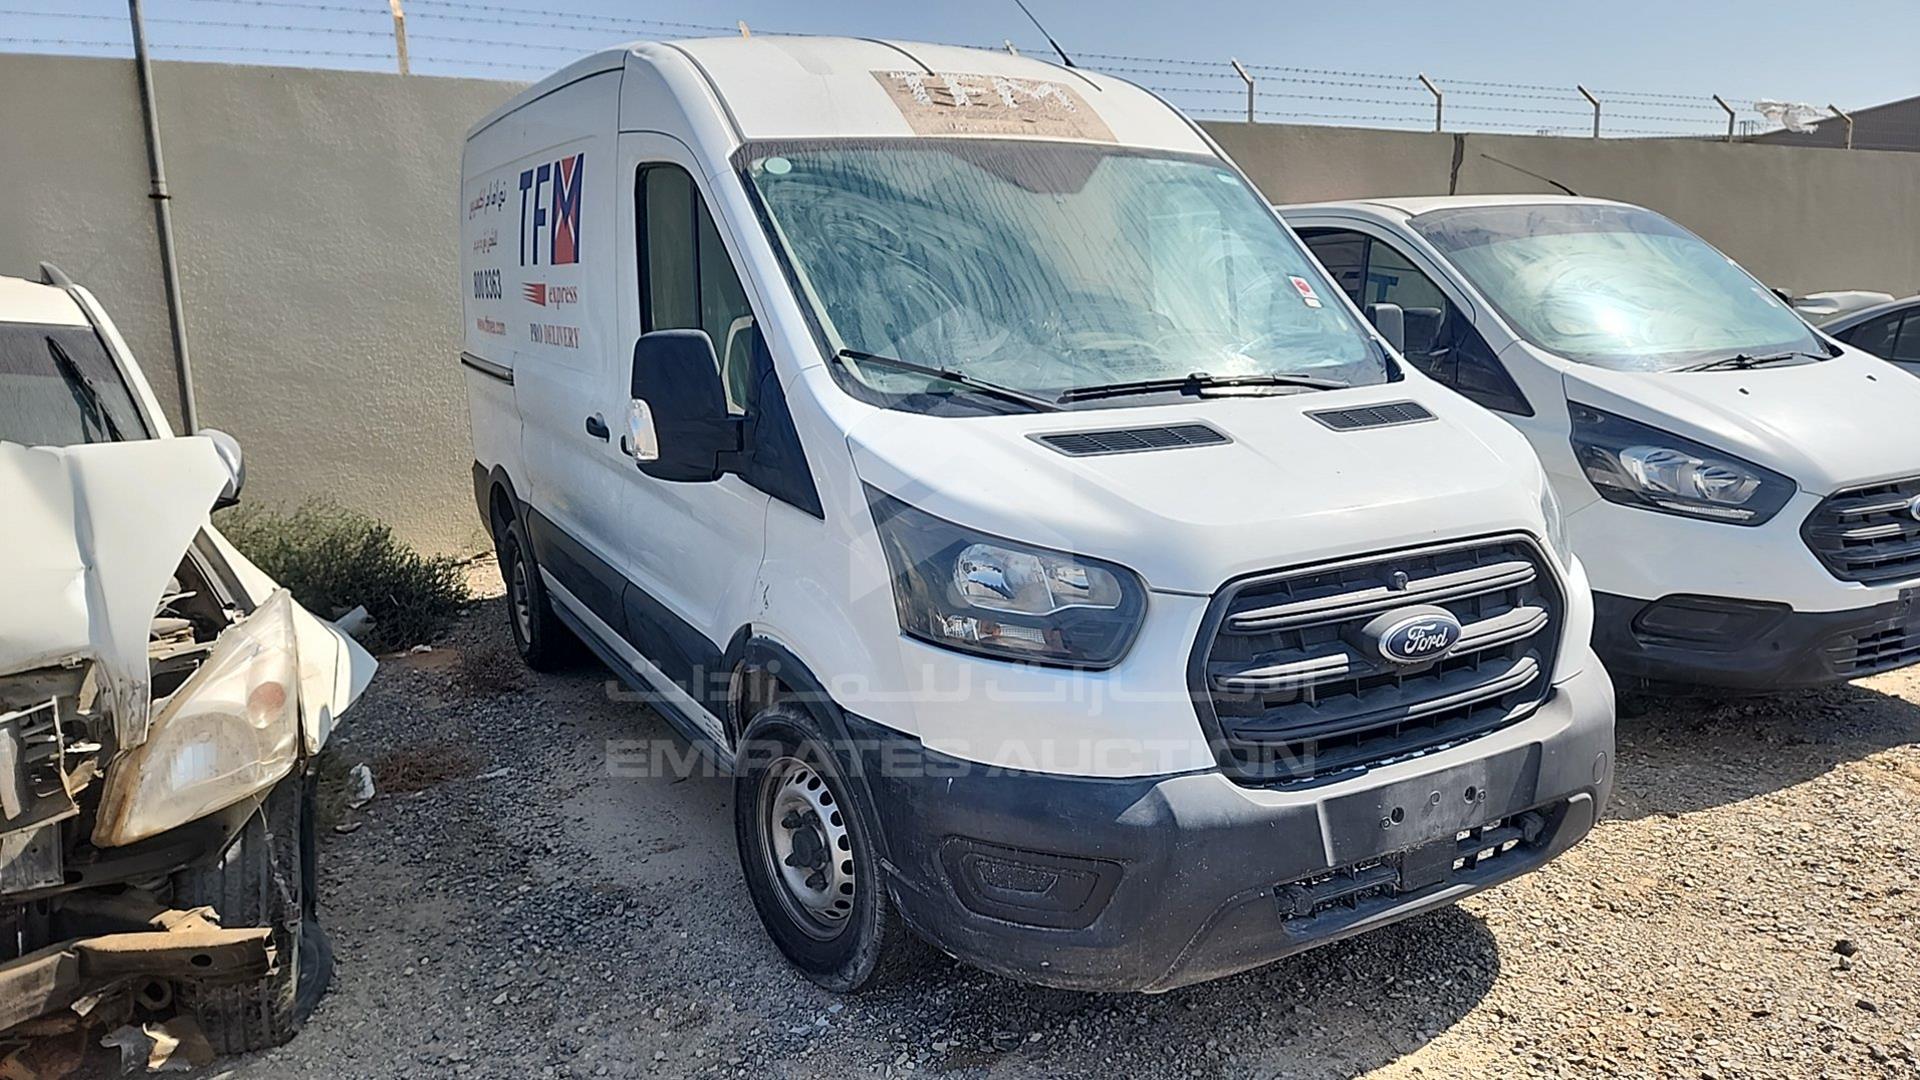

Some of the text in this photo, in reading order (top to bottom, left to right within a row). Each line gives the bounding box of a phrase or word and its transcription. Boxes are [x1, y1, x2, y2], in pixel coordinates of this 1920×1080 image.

[887, 71, 1078, 112] TFM
[519, 153, 584, 266] TFM
[549, 286, 578, 310] express
[530, 323, 543, 344] PRO
[544, 324, 580, 349] DELIVERY
[1404, 623, 1448, 654] Ford
